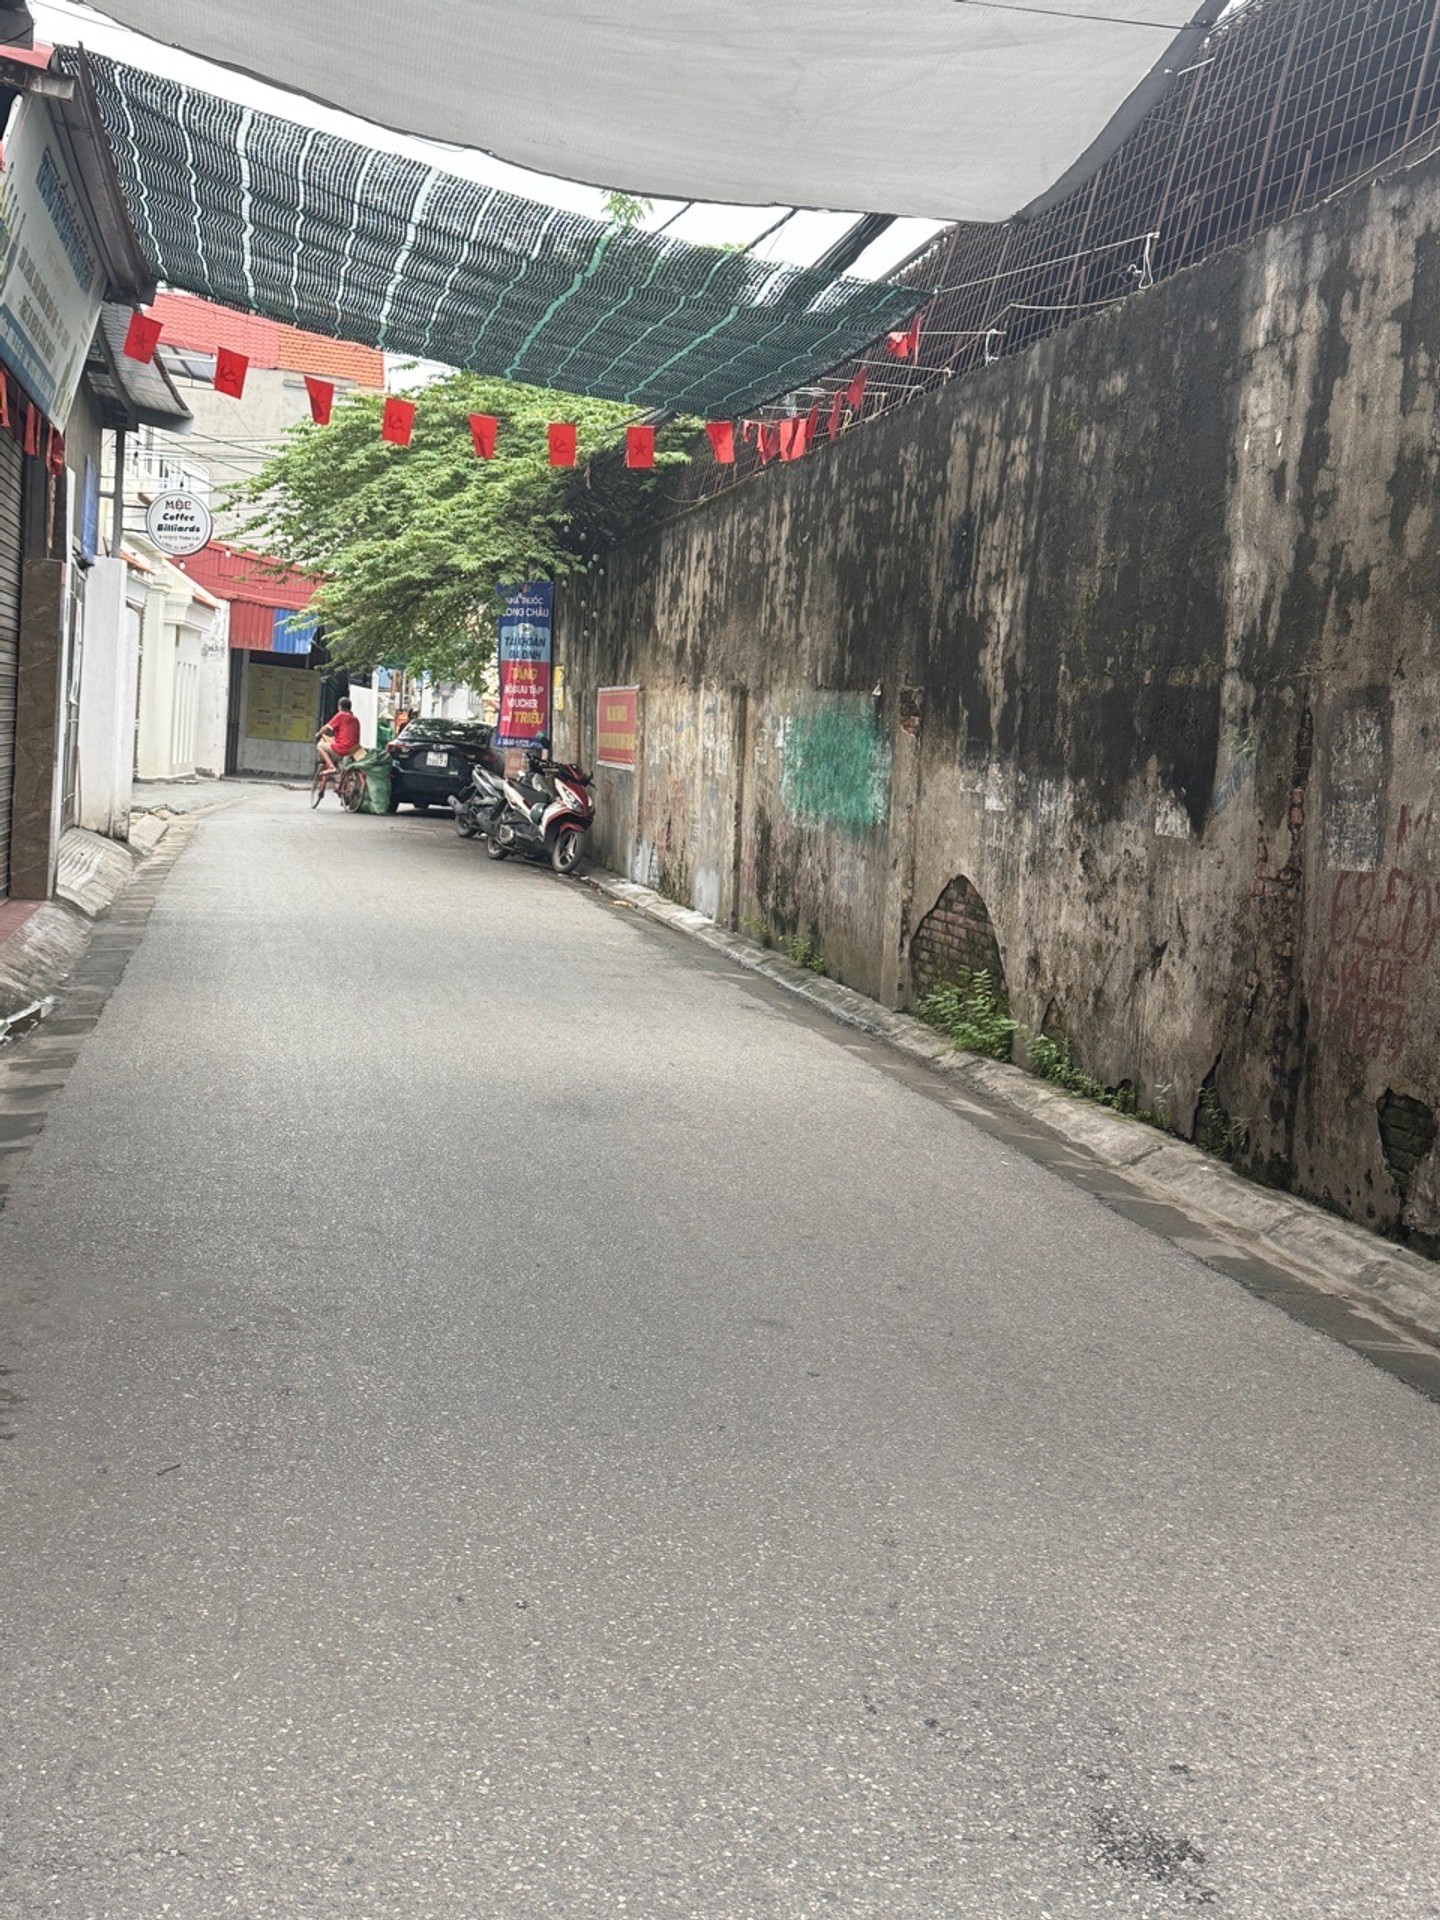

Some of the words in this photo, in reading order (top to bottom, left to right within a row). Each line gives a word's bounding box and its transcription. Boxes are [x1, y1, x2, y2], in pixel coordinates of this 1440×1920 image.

[162, 512, 195, 521] Coffee
[157, 523, 200, 532] Billiards
[525, 607, 549, 618] CHÂU
